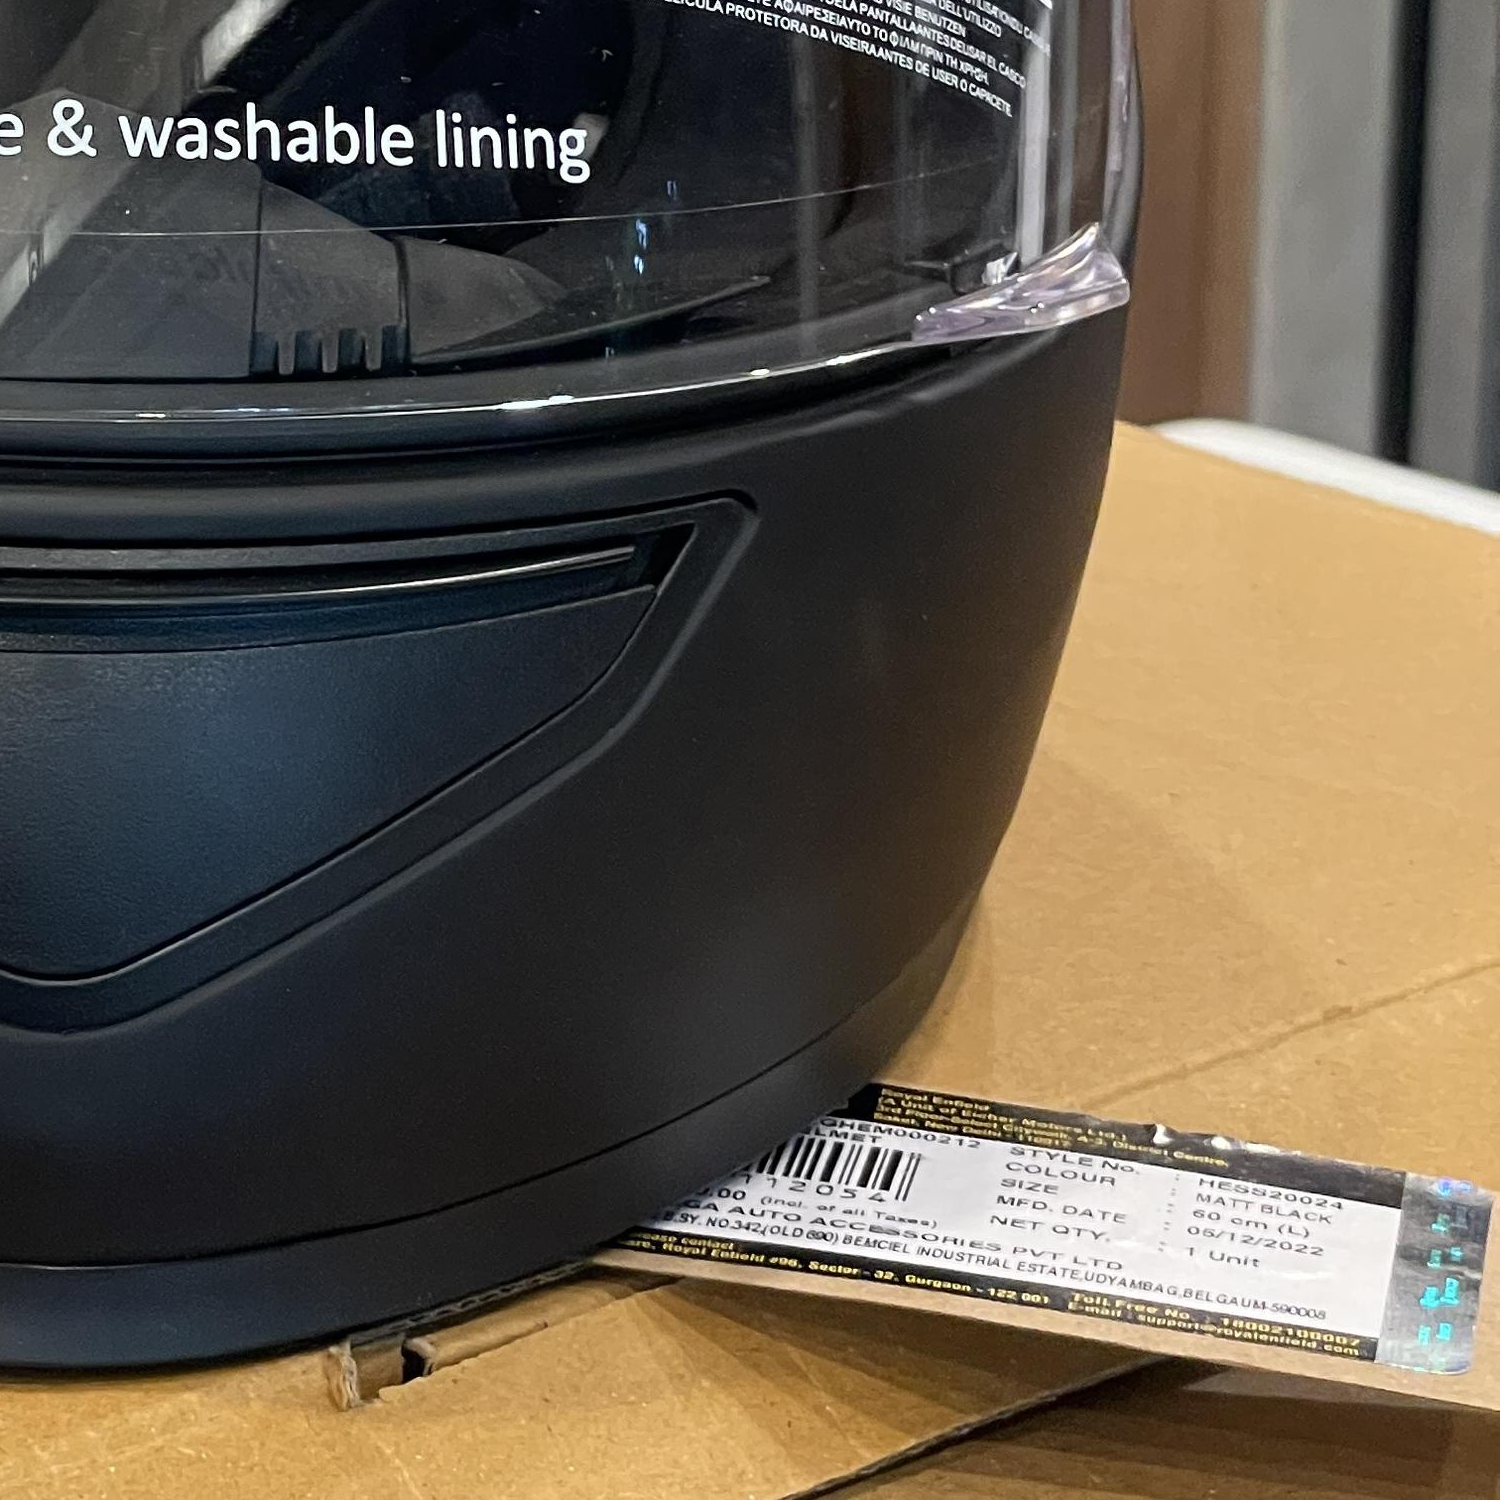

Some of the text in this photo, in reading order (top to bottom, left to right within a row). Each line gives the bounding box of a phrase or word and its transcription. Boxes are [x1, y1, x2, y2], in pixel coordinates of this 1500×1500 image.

[725, 3, 808, 36] PROTETORA
[809, 25, 829, 42] DA
[47, 99, 97, 157] &
[118, 102, 414, 165] washable
[436, 109, 590, 183] lining
[1009, 1146, 1093, 1169] STYLE
[1000, 1177, 1059, 1195] SIZE
[1005, 1162, 1116, 1187] COLOUR
[990, 1214, 1044, 1231] NET
[996, 1195, 1128, 1224] MFD. DATE
[1196, 1192, 1334, 1226] MATT BLACK
[728, 1206, 802, 1222] AUTO
[1012, 1246, 1064, 1261] PVT
[1073, 1255, 1123, 1271] LTD
[1192, 1209, 1311, 1239] 60 cm (L)
[1208, 1250, 1260, 1268] Unit
